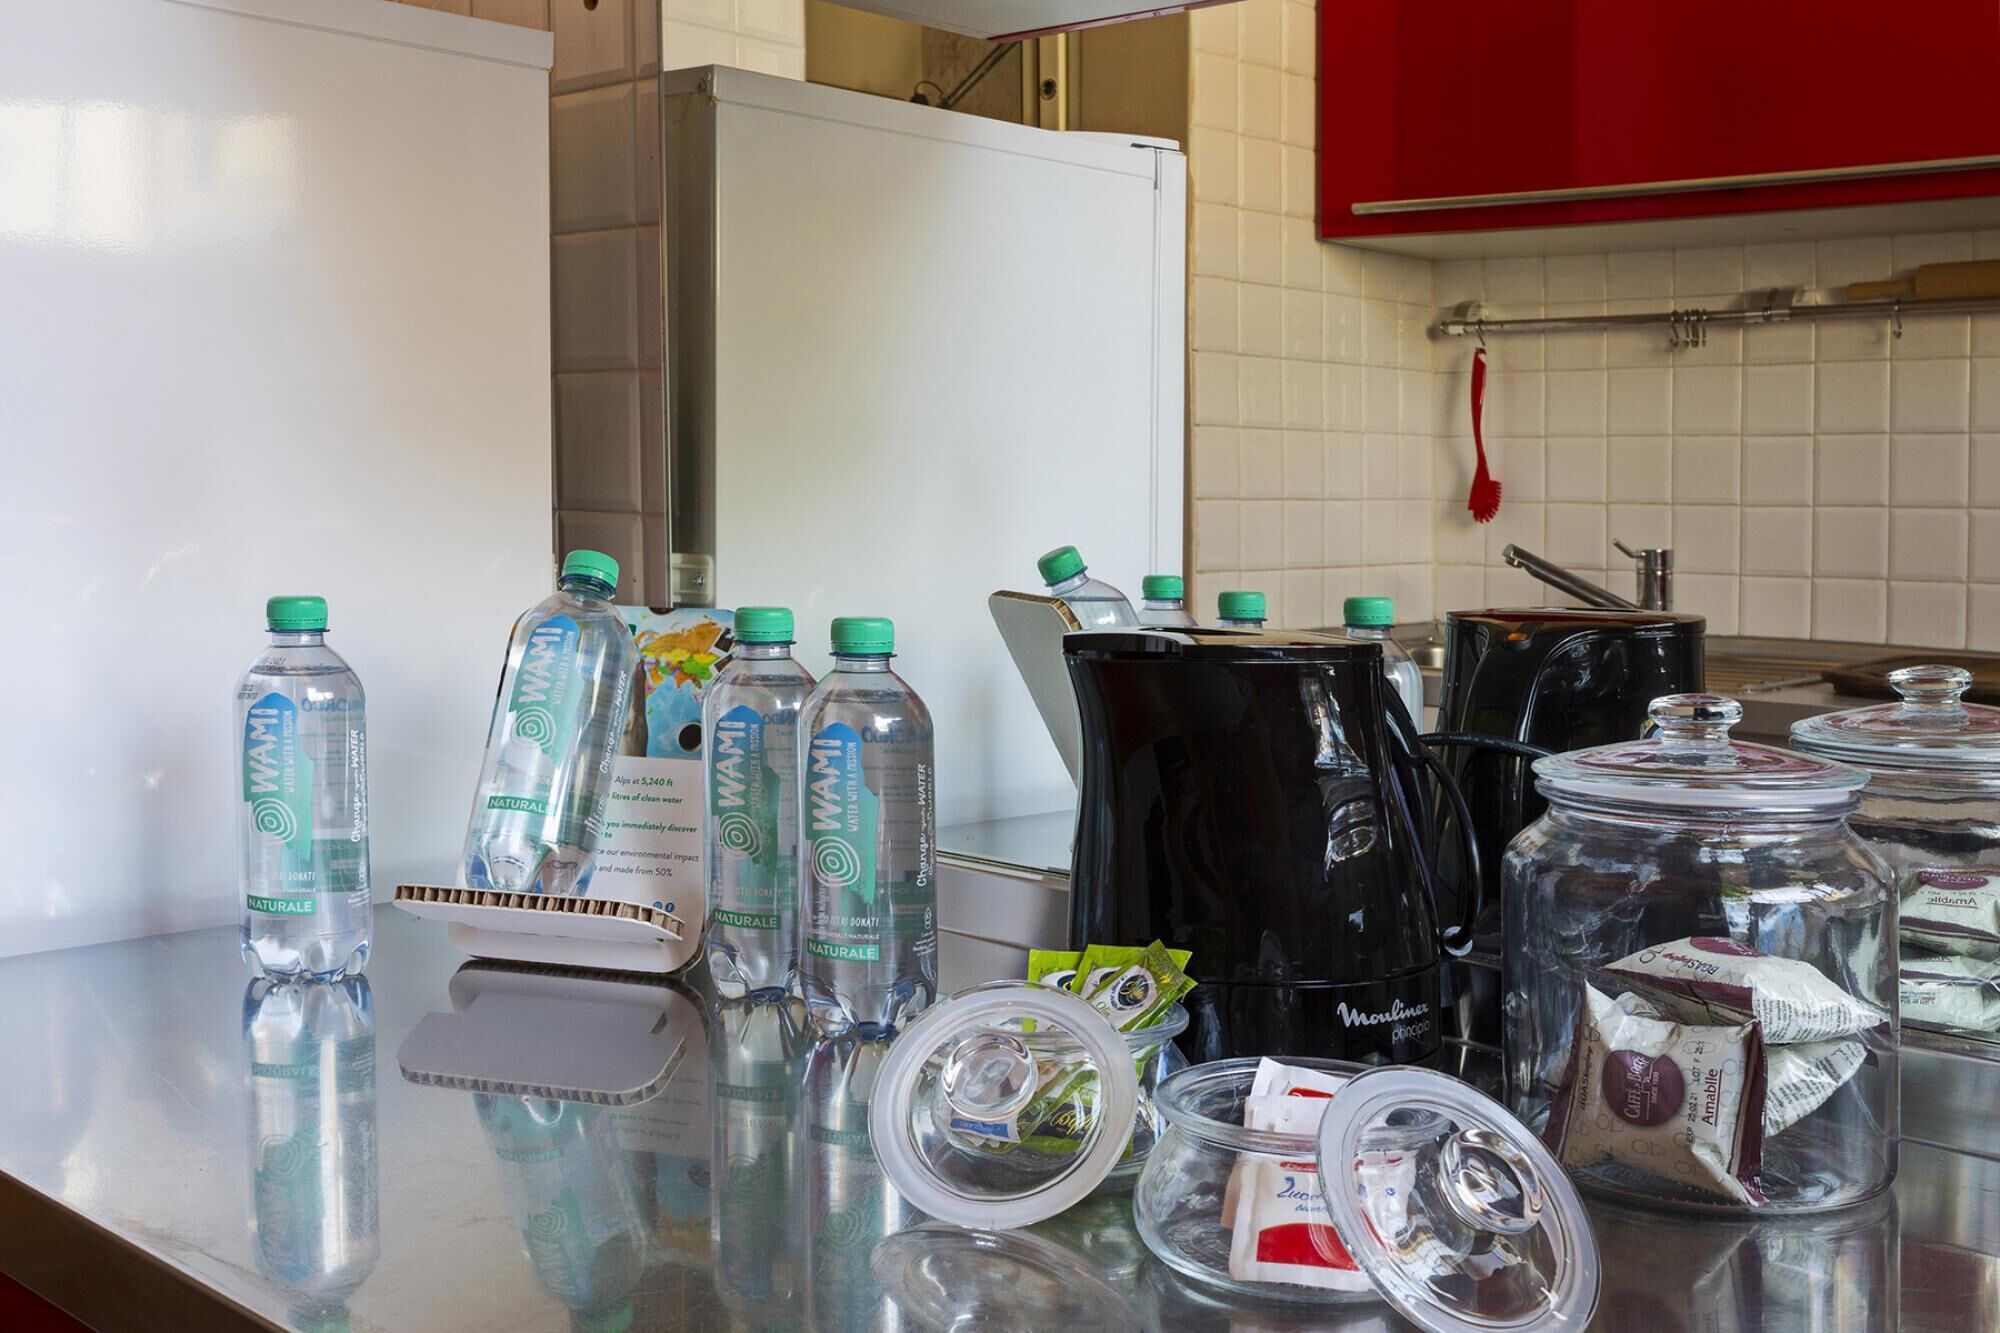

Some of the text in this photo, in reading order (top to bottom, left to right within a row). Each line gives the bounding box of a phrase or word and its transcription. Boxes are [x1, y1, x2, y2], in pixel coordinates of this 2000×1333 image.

[518, 628, 563, 702] WAMI
[249, 708, 280, 793] WAMI
[350, 729, 359, 768] WATER
[846, 741, 858, 771] MISSION
[716, 721, 746, 807] WAMI
[614, 775, 631, 786] Alps
[641, 776, 665, 787] 5,240
[666, 777, 673, 787] ft
[811, 739, 842, 830] WAMI
[847, 780, 859, 802] WITH
[916, 763, 926, 805] WATER
[489, 798, 546, 814] NATURAL
[611, 791, 630, 801] litres
[631, 792, 641, 801] of
[641, 793, 660, 803] clean
[350, 792, 361, 843] Change
[606, 821, 619, 830] you
[621, 820, 666, 833] immediately
[667, 823, 697, 834] discover
[847, 803, 859, 832] WATER
[620, 850, 673, 861] environmental
[674, 851, 700, 864] impact
[915, 832, 928, 887] Change
[598, 864, 673, 878] and made from 50%
[248, 898, 313, 913] NATURALE
[713, 910, 777, 928] NATURALE
[850, 916, 880, 928] DONATI
[808, 942, 875, 960] NATURALE
[1701, 1067, 1719, 1126] Amabile
